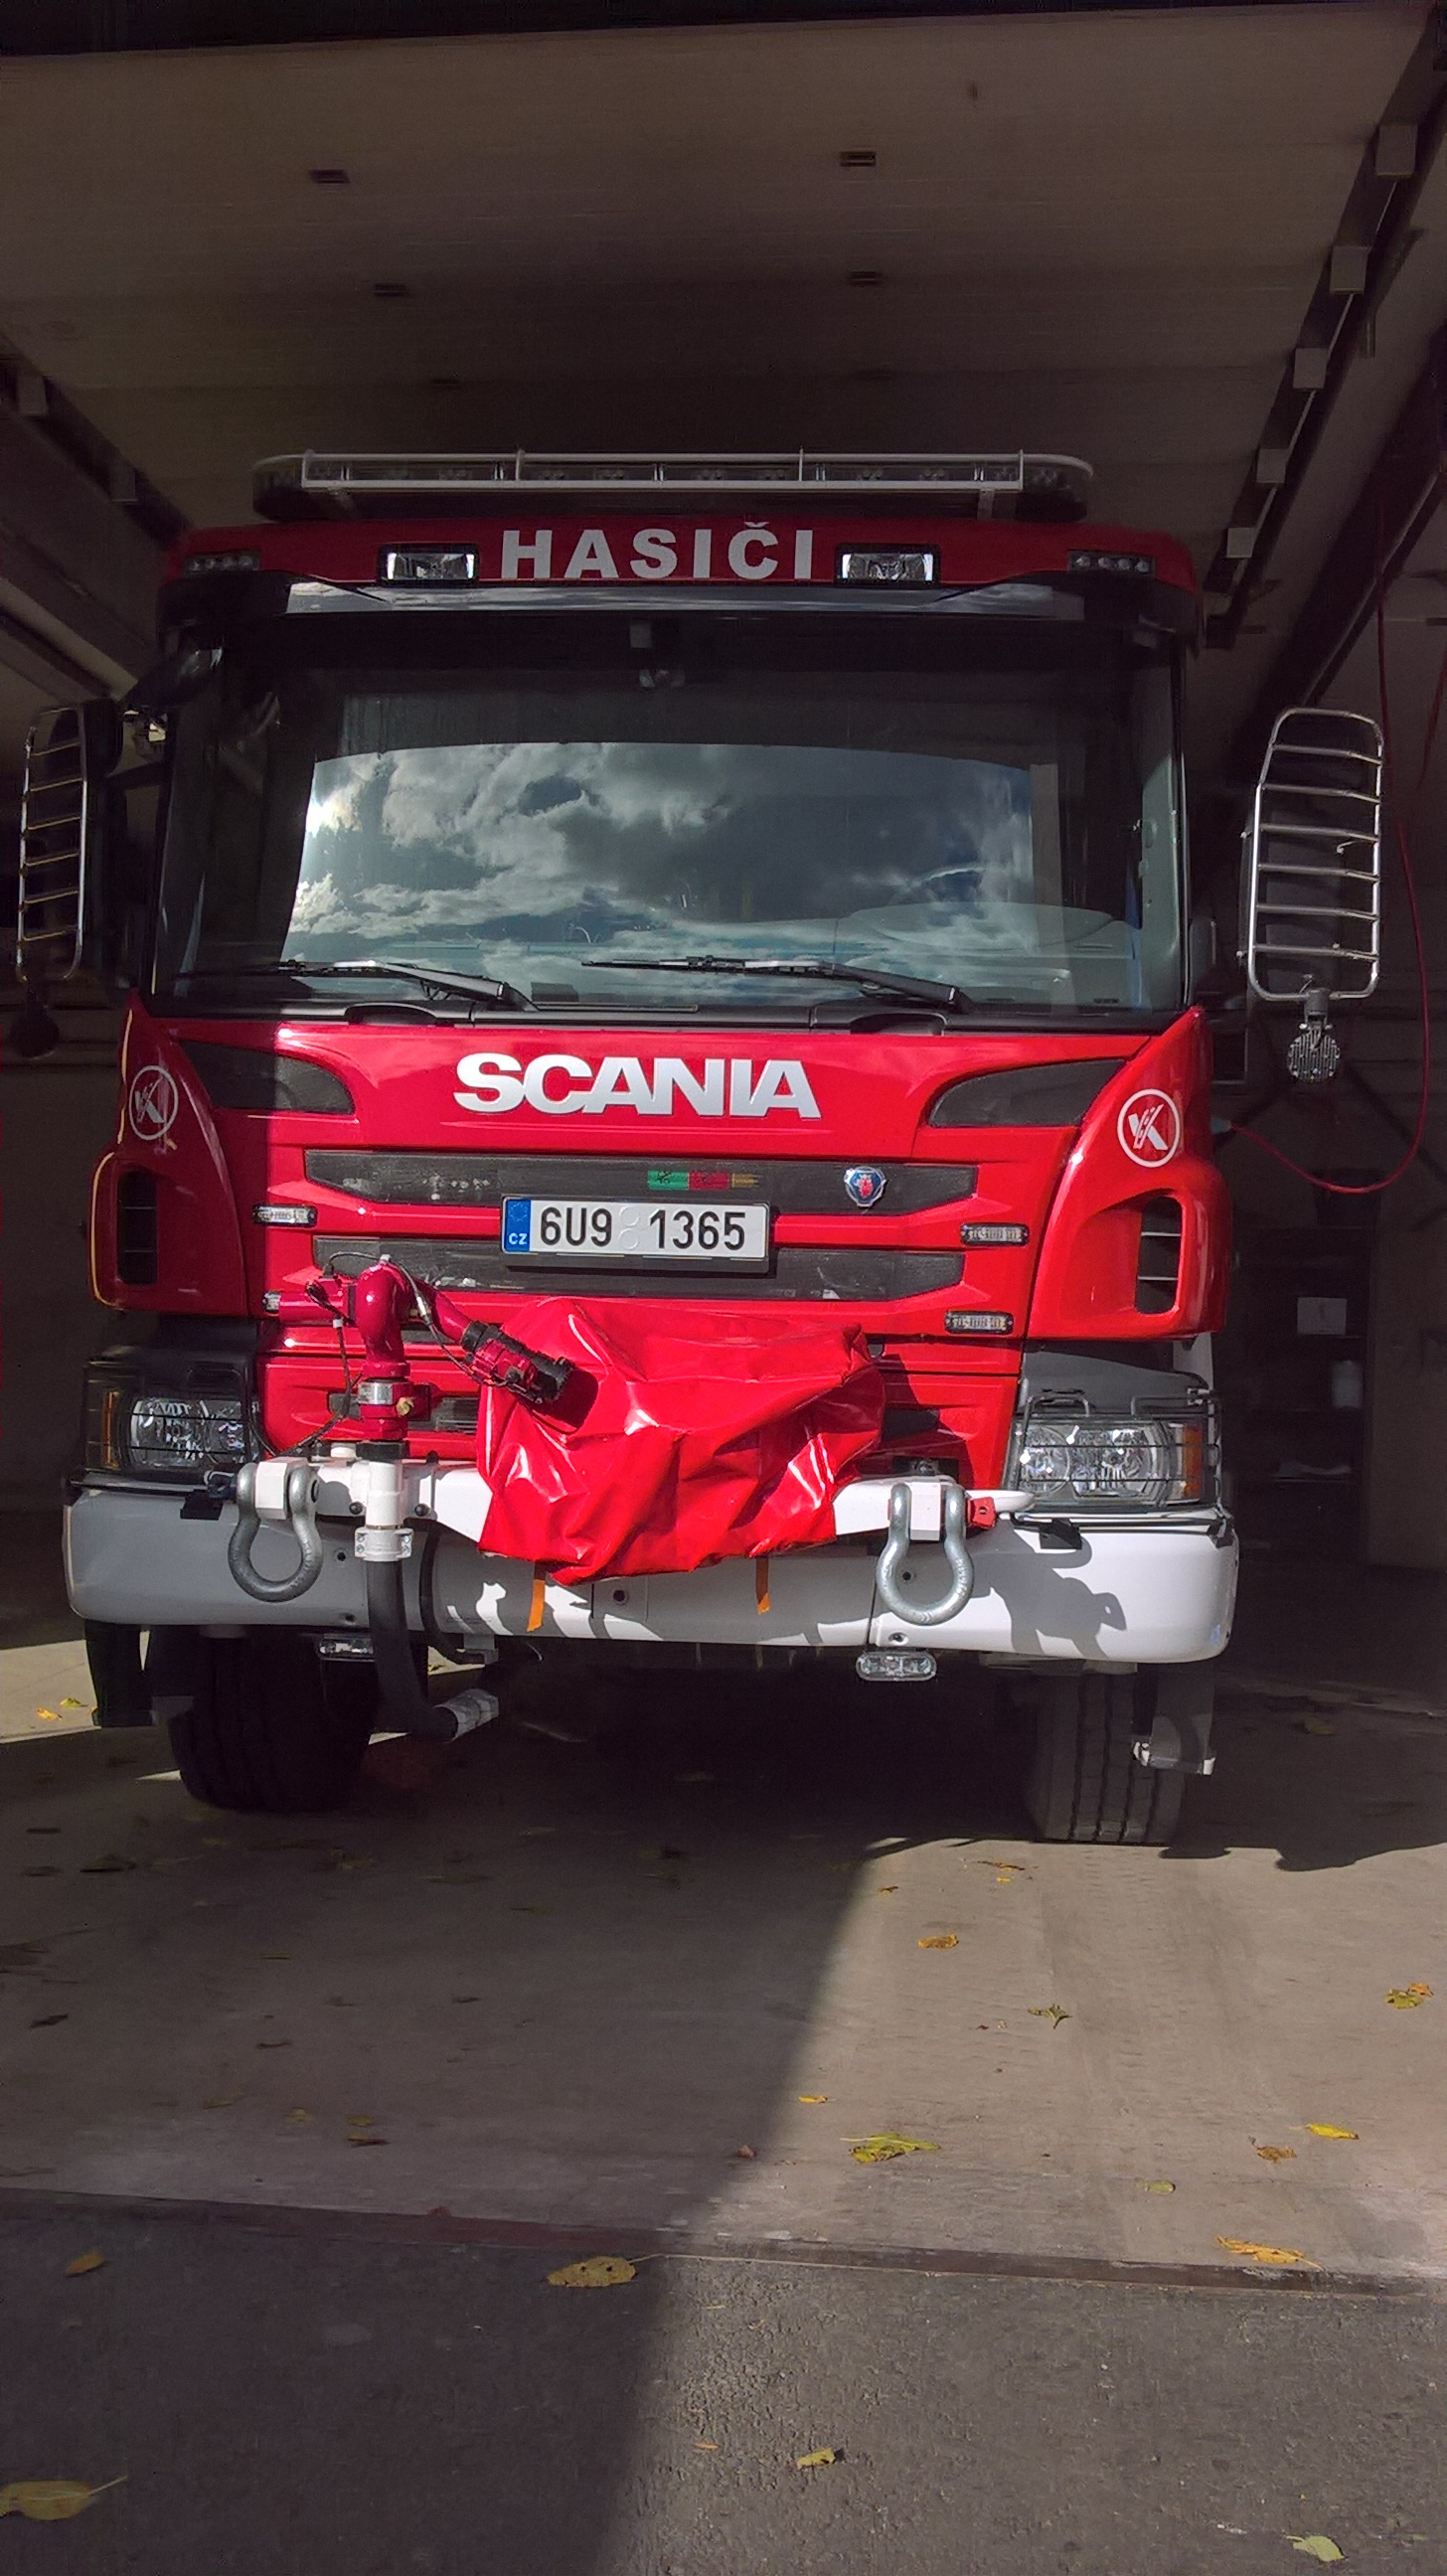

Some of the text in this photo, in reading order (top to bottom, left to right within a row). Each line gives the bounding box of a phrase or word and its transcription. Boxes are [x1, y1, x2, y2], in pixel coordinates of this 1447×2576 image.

[500, 521, 813, 580] HASIČI
[453, 1052, 822, 1119] SCANIA
[508, 1232, 528, 1245] CZ
[540, 1207, 745, 1251] 6U9 1365
